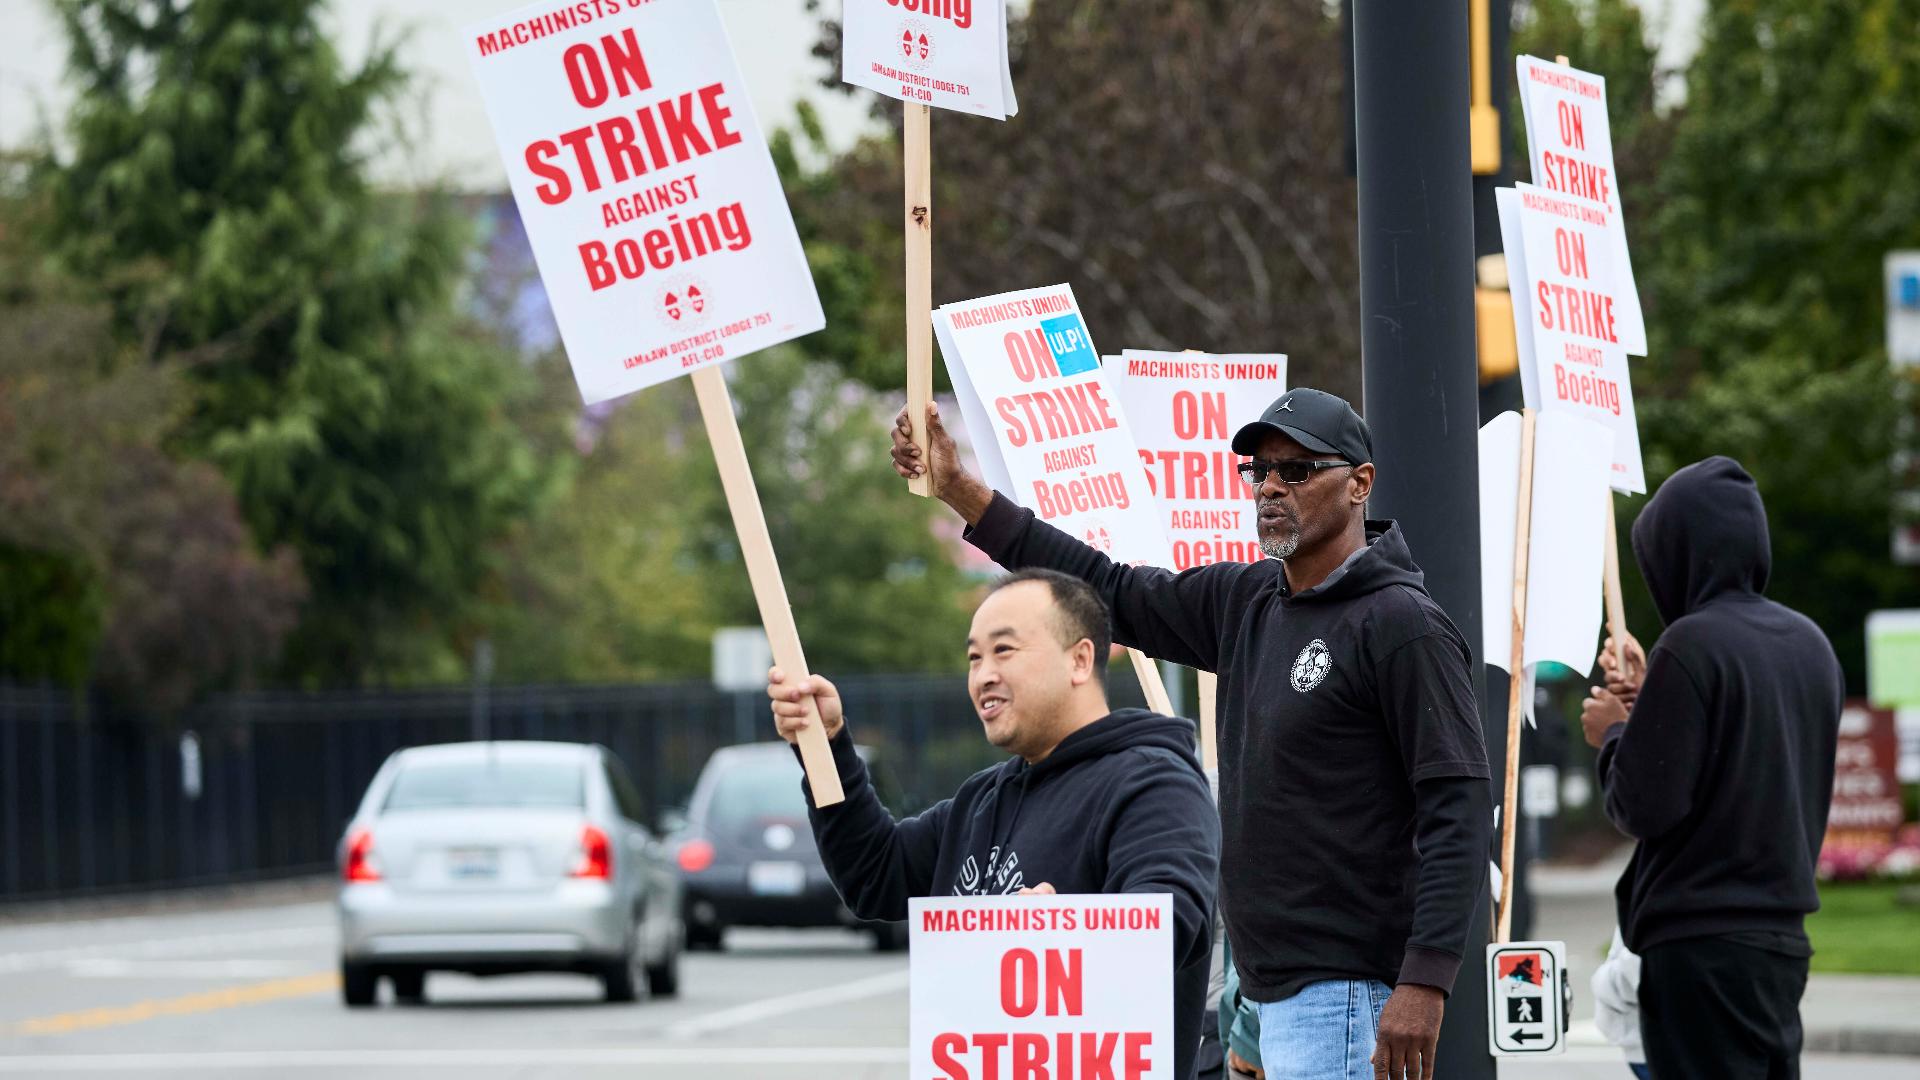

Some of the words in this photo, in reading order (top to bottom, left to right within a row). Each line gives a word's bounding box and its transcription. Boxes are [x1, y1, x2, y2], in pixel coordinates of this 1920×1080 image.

[477, 0, 621, 56] MACHINISTS
[562, 27, 653, 109] ON
[871, 62, 897, 79] IAM&AW
[897, 70, 931, 88] DISTRICT
[931, 79, 956, 94] LODGE
[956, 83, 970, 96] 751
[901, 85, 932, 102] AFL-CIO
[524, 82, 742, 205] STRIKE
[1557, 99, 1585, 151] ON
[601, 174, 700, 228] AGAINST
[1522, 192, 1580, 220] MACHINISTS
[1580, 206, 1607, 227] UNION
[577, 202, 752, 291] Boeing
[1554, 227, 1589, 280] ON
[950, 298, 1032, 330] MACHINISTS
[1031, 292, 1073, 315] UNION
[1537, 280, 1618, 344] STRIKE
[624, 346, 668, 369] IAM&AW
[671, 329, 718, 355] DISTRICT
[720, 320, 752, 339] LODGE
[754, 312, 772, 327] 751
[682, 345, 724, 368] AFL-CIO
[1003, 327, 1059, 383] ON
[1048, 326, 1087, 355] ULP!
[1564, 342, 1604, 370] AGAINST
[1127, 359, 1221, 379] MACHINISTS
[1224, 363, 1278, 380] UNION
[1554, 363, 1621, 416] Boeing
[995, 380, 1118, 448] STRIKE
[1171, 390, 1229, 441] ON
[1043, 444, 1097, 474] AGAINST
[1032, 470, 1131, 520] Boeing
[1171, 510, 1241, 530] AGAINST
[922, 908, 1077, 932] MACHINISTS
[1084, 907, 1161, 930] UNION
[1000, 947, 1083, 1018] ON
[930, 1031, 1153, 1080] STRIKE
